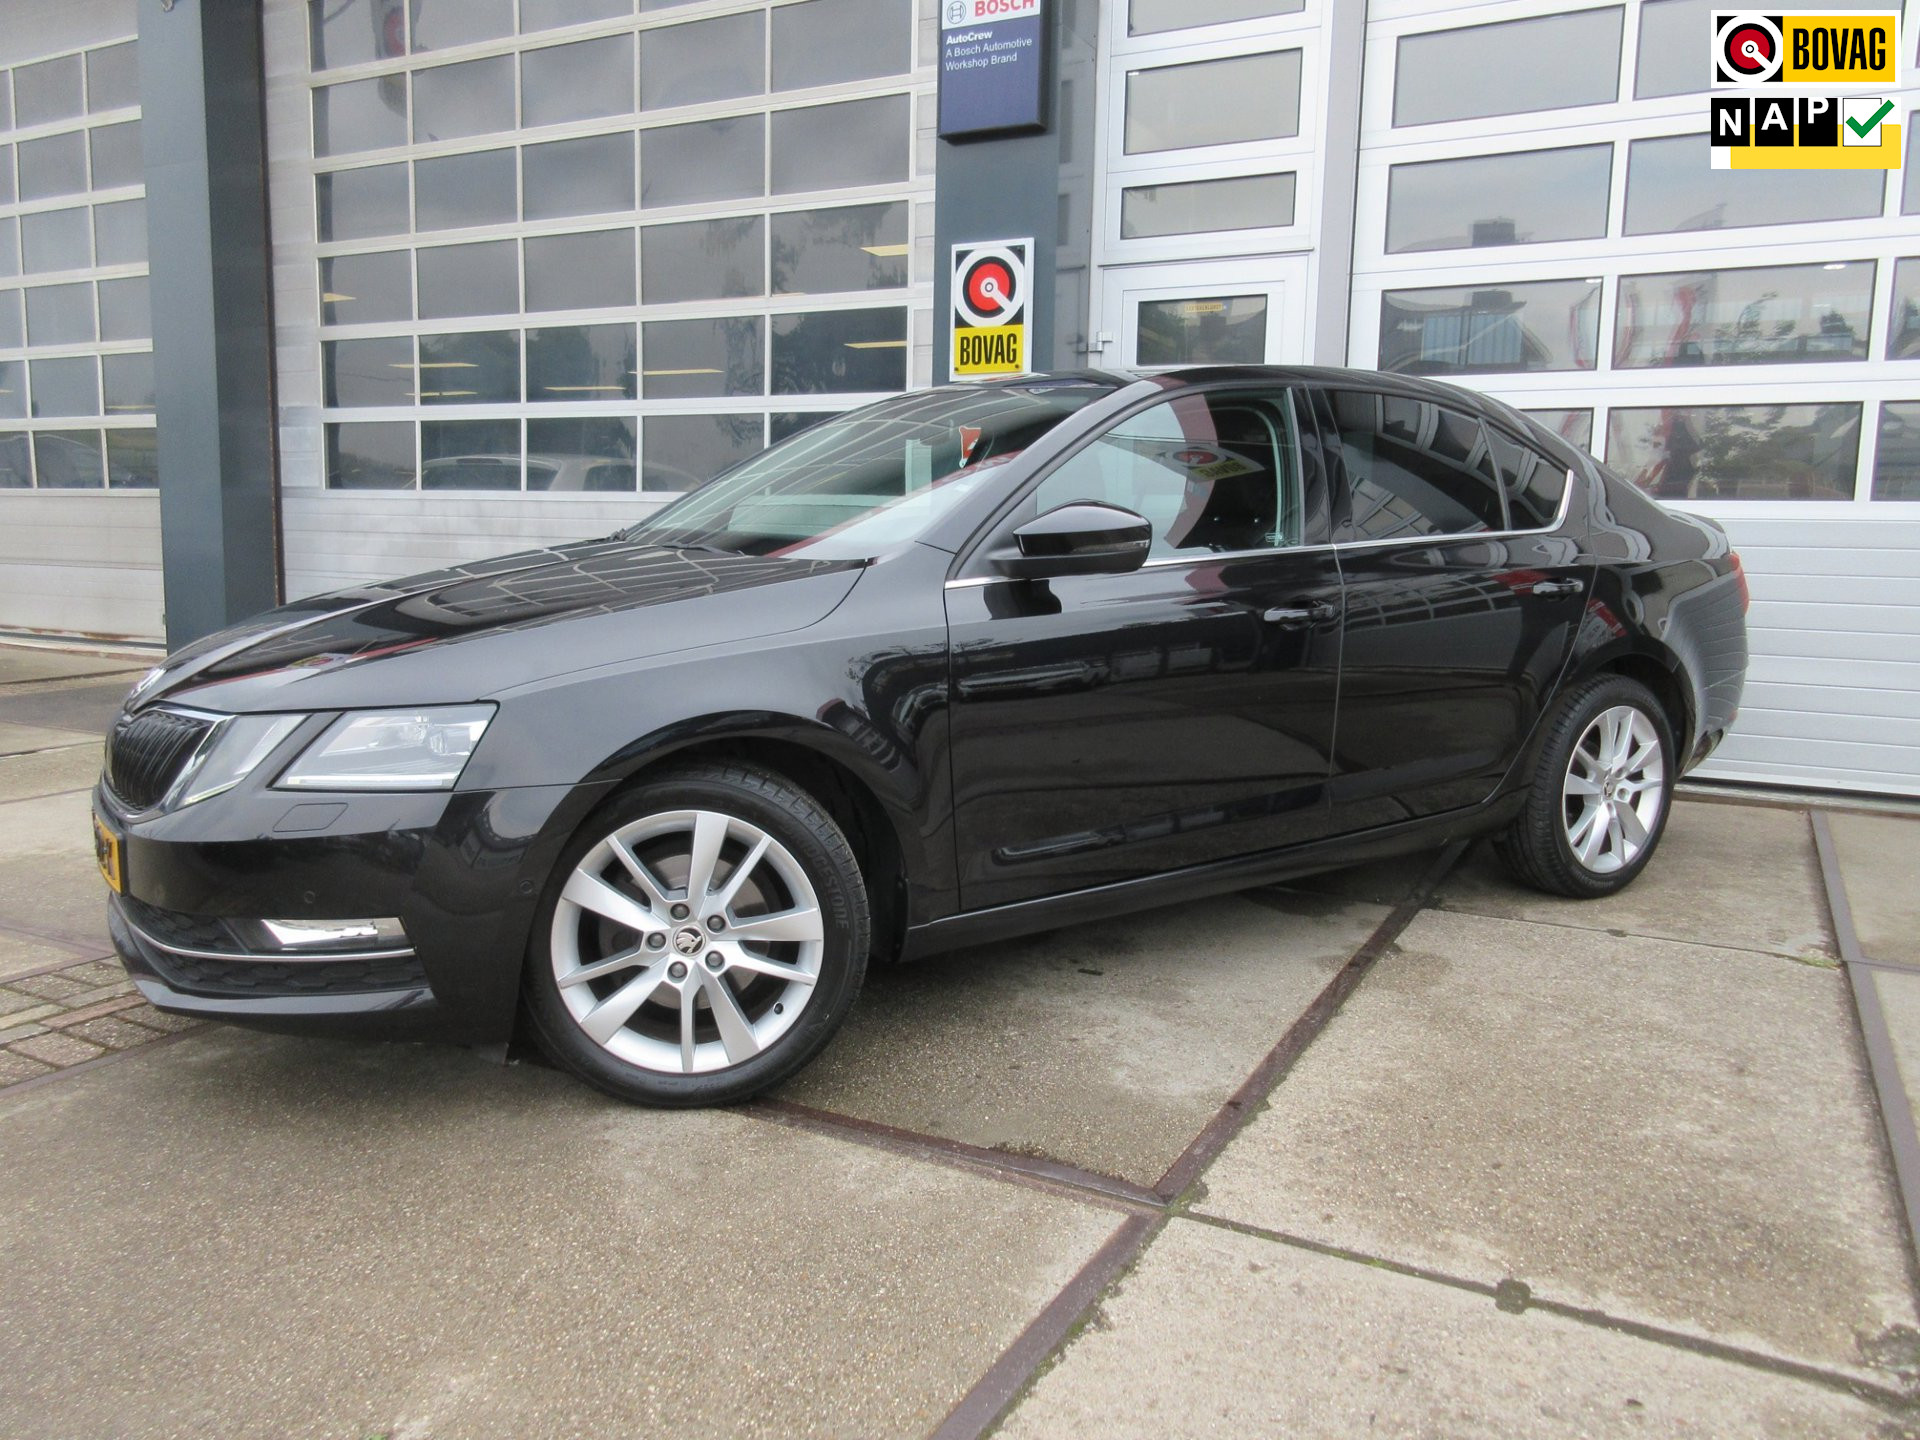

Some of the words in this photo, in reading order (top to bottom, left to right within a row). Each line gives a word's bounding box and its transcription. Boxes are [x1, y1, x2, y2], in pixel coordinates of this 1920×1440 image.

[974, 0, 1034, 17] BOSCH
[946, 30, 993, 45] AutoCrew
[946, 49, 953, 58] A
[954, 45, 981, 57] Bosch
[983, 37, 1033, 53] Automotive
[946, 58, 989, 72] Workshop
[991, 53, 1018, 66] Brand
[960, 333, 1018, 366] BOVAG
